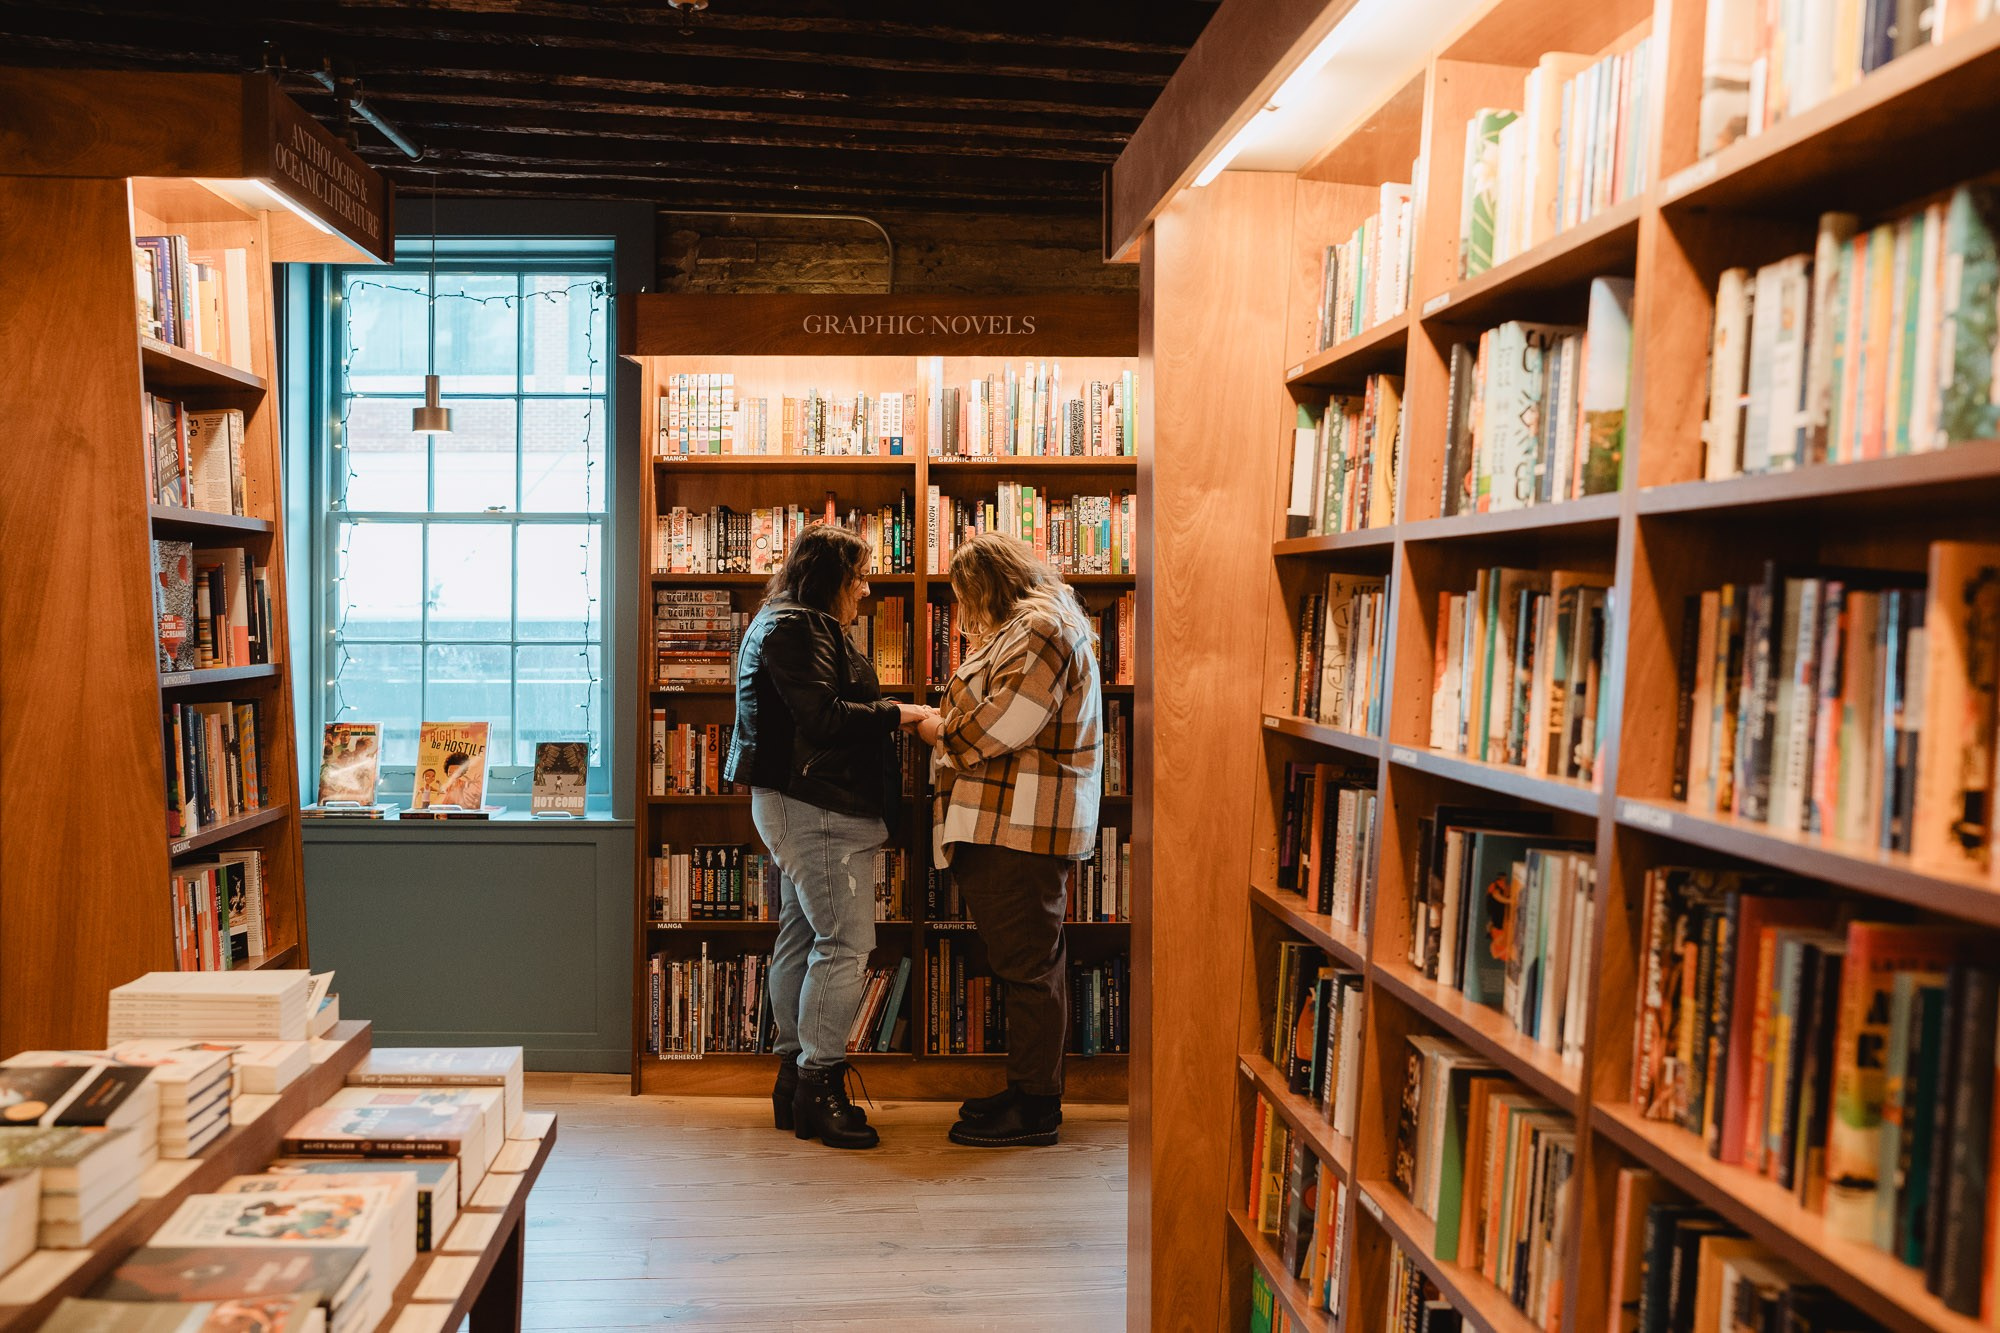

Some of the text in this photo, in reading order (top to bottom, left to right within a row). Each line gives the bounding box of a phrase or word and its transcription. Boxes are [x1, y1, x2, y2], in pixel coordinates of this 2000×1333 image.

[291, 123, 368, 204] ANTHOLOGIES &
[275, 142, 380, 240] OCEANIC LITERATURE
[802, 314, 1037, 335] GRAPHIC NOVELS
[995, 383, 1004, 427] BLACK HOLE
[892, 438, 900, 446] 2
[928, 505, 936, 548] MONSTERS
[667, 591, 703, 602] UZUMAKI
[163, 614, 174, 622] OUT
[668, 606, 704, 617] UZUMAKI
[1119, 602, 1127, 631] GEORGE
[161, 622, 177, 630] THERE
[1119, 631, 1127, 657] ORWELL
[163, 674, 191, 686] ANTHOLOGIES
[421, 734, 427, 743] a
[430, 729, 457, 743] RIGHT
[431, 740, 441, 750] be
[533, 796, 584, 808] HOT COMB
[172, 840, 191, 854] OCEANIC
[928, 867, 936, 908] ALICE GUY
[1330, 977, 1339, 1006] ANNIE
[1323, 1047, 1334, 1103] BARKSKINS
[302, 1142, 326, 1150] ALICE
[327, 1142, 356, 1150] WALKER
[391, 1143, 416, 1151] COLOR
[417, 1143, 443, 1151] PURPLE
